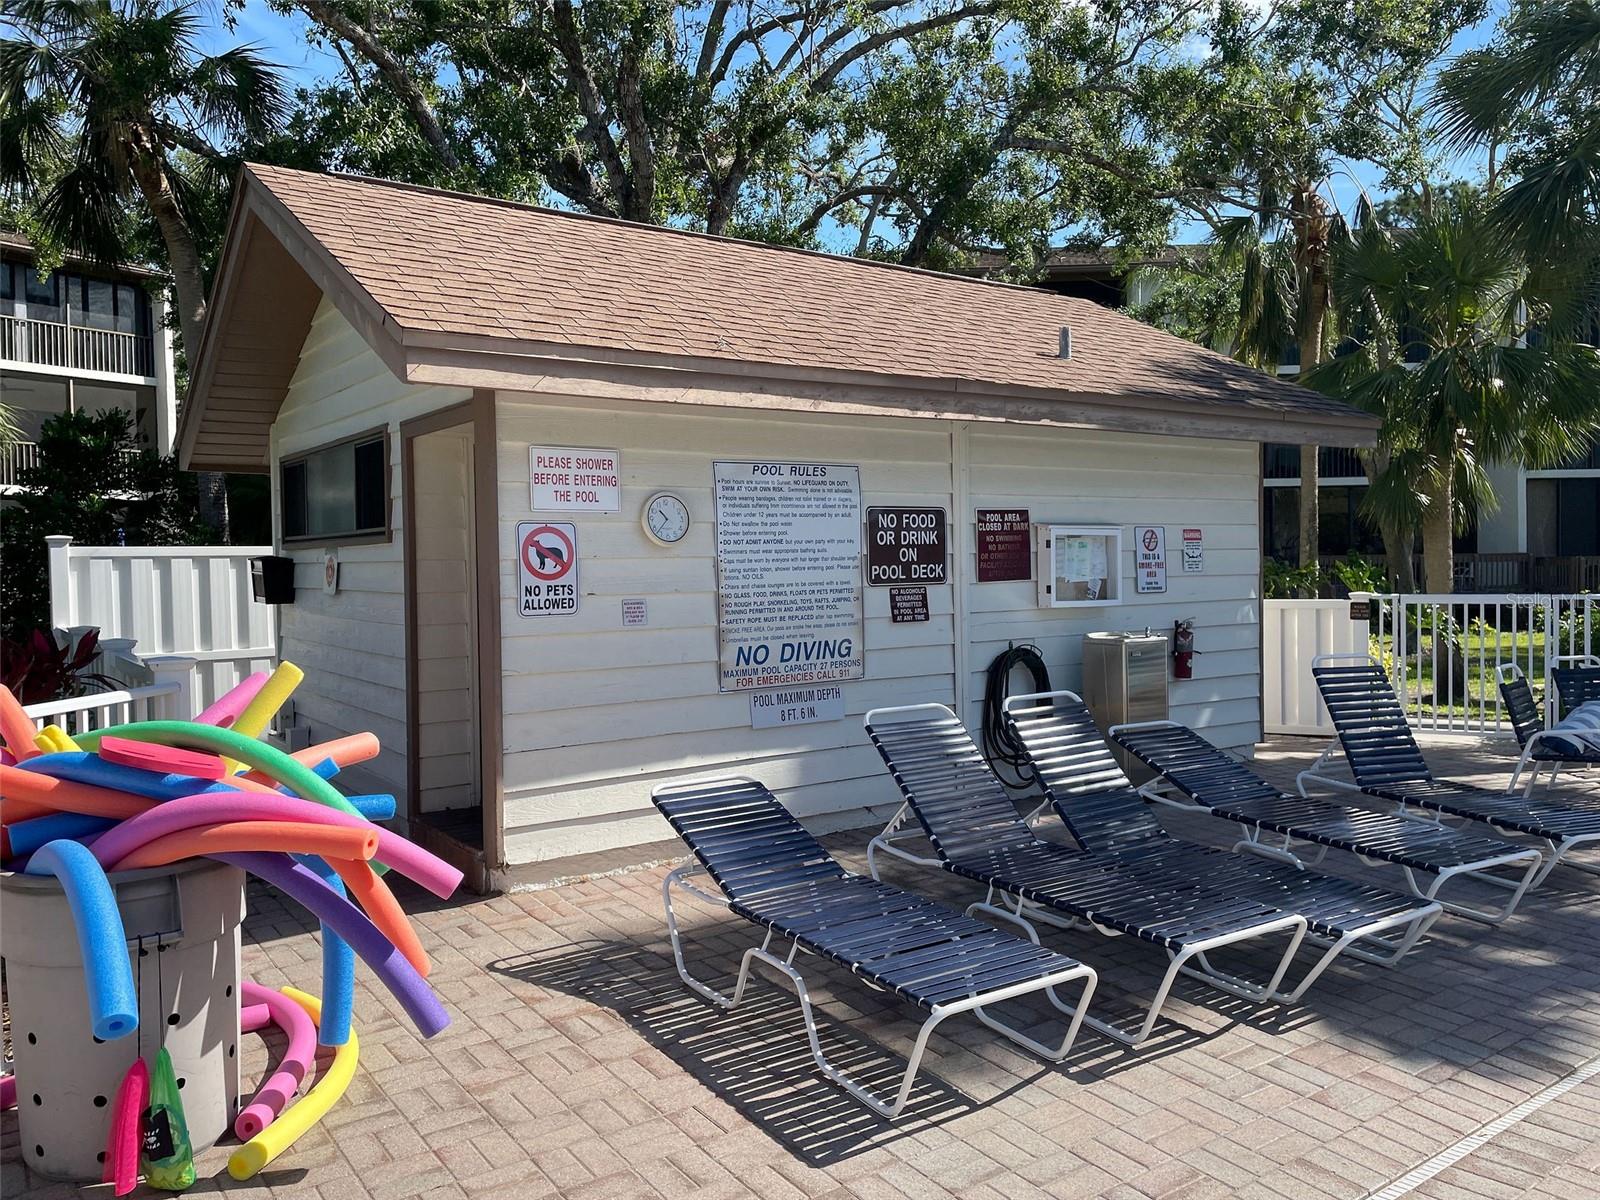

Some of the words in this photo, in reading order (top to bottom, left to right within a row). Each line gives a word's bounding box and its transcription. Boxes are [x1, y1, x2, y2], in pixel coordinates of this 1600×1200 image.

[537, 456, 572, 469] PLEASE
[576, 458, 614, 471] SHOWER
[752, 465, 784, 476] POOL
[790, 466, 826, 476] RULES
[534, 473, 570, 485] BEFORE
[574, 474, 617, 487] ENTERING
[554, 490, 570, 502] THE
[576, 491, 600, 502] POOL
[878, 514, 897, 528] NO
[902, 514, 936, 528] FOOD
[986, 514, 1002, 522] POOL
[1004, 514, 1020, 522] AREA
[978, 522, 1002, 531] CLOSED
[1004, 522, 1011, 530] AT
[1012, 522, 1029, 530] DARK
[876, 530, 895, 546] OR
[901, 530, 938, 545] DRINK
[900, 548, 918, 562] ON
[872, 565, 906, 580] POOL
[912, 564, 944, 578] DECK
[524, 585, 540, 598] NO
[546, 584, 574, 596] PETS
[524, 598, 575, 610] ALLOWED
[736, 644, 770, 666] NO
[780, 638, 852, 663] DIVING
[724, 669, 758, 678] MAXIMUM
[762, 666, 781, 675] POOL
[784, 663, 817, 674] CAPACITY
[820, 662, 828, 670] 27
[830, 659, 860, 669] PERSONS
[736, 678, 754, 688] FOR
[756, 672, 814, 686] EMERGENCIES
[816, 670, 836, 680] CALL
[840, 669, 850, 678] 911
[754, 694, 774, 708] POOL
[776, 690, 816, 705] MAXIMUM
[818, 687, 840, 700] DEPTH
[780, 710, 786, 722] 8
[788, 708, 799, 721] FT.
[800, 708, 805, 720] 6
[808, 706, 818, 718] IN.
